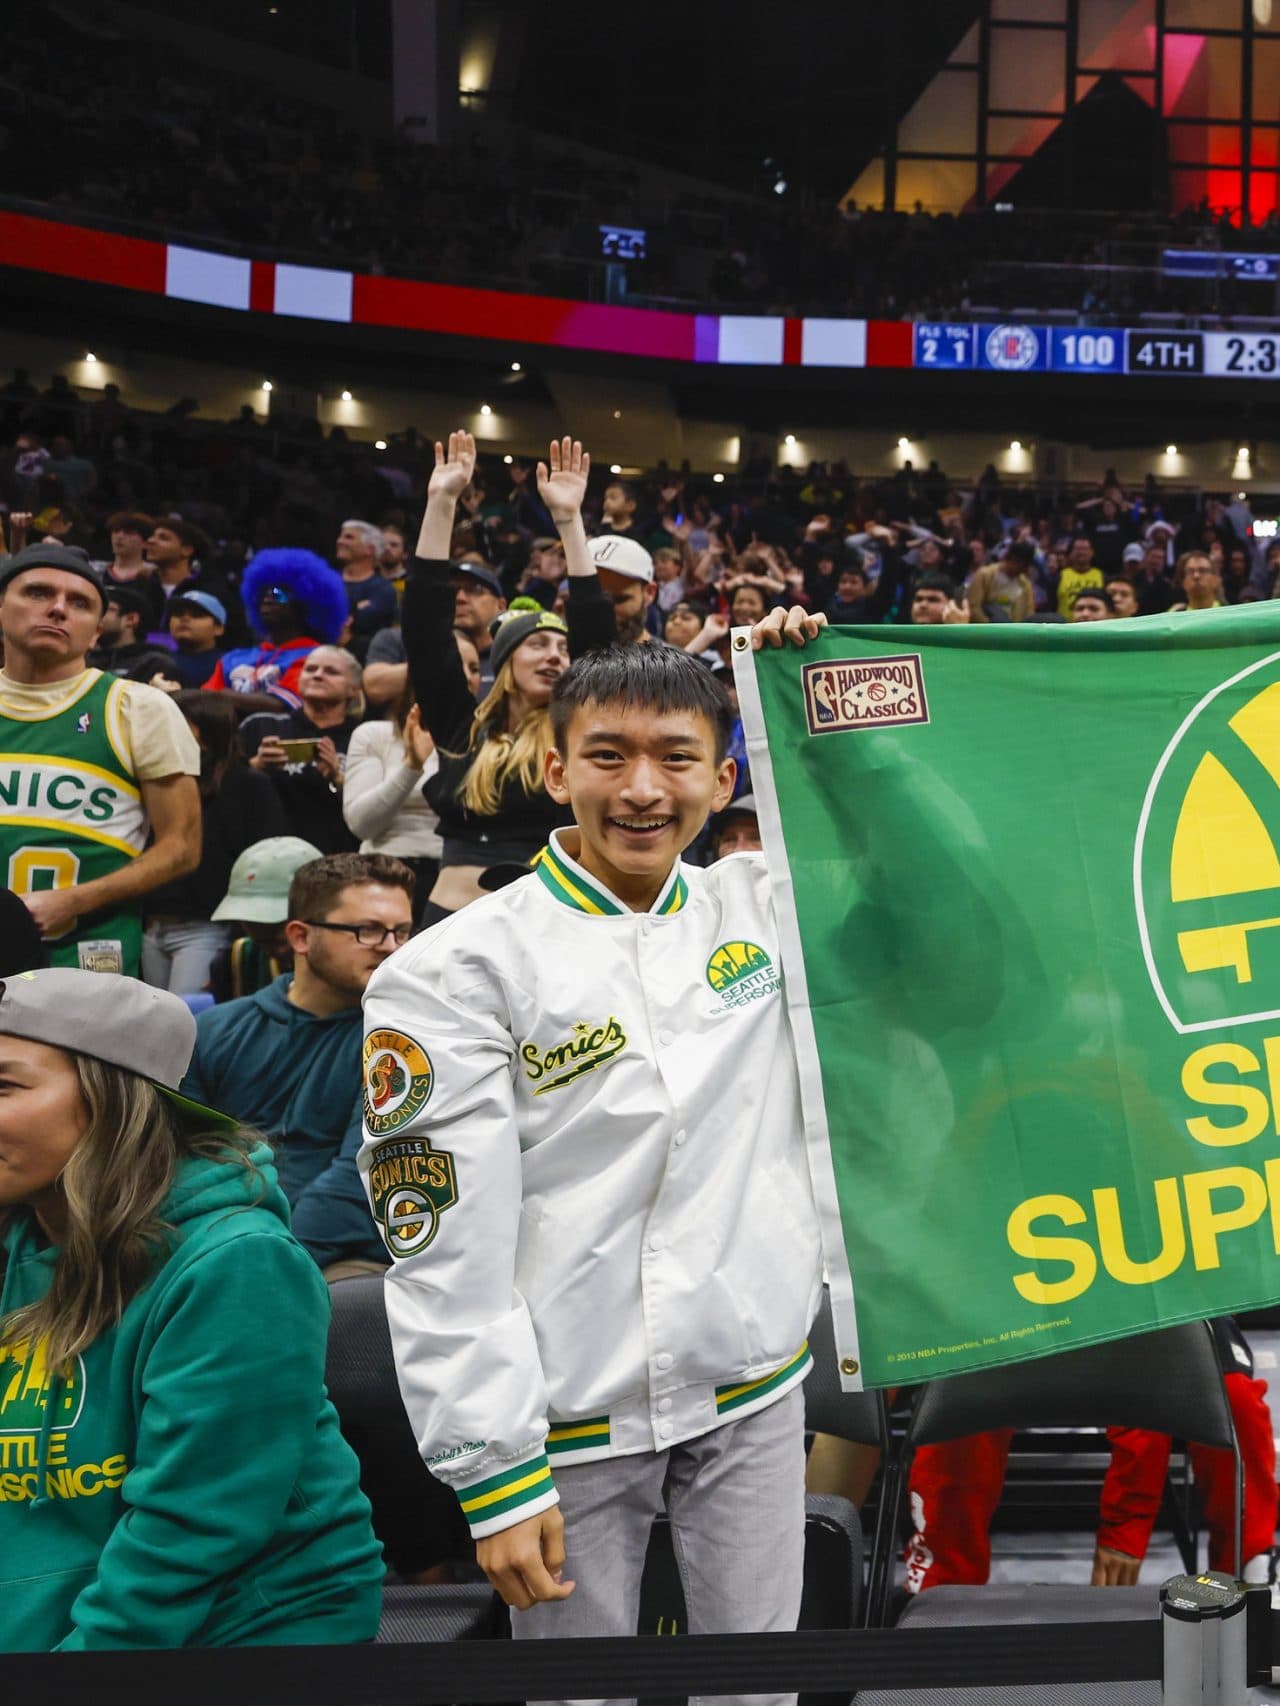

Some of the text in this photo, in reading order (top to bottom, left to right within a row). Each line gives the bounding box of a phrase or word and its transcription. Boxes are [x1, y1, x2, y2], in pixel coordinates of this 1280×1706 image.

[923, 340, 965, 363] 2 1
[1062, 335, 1114, 365] 100
[1136, 341, 1194, 367] 4TH
[836, 666, 913, 698] HARDWOOD
[840, 692, 917, 720] CLASSICS
[721, 967, 776, 1002] SEATTLE
[521, 1016, 627, 1084] Sonics
[376, 1142, 423, 1164] SEATTLE
[372, 1156, 448, 1201] SONICS
[897, 1352, 917, 1361] 2013
[918, 1347, 936, 1358] NBA
[1000, 1332, 1009, 1342] All
[1010, 1327, 1034, 1341] Rights
[0, 1433, 68, 1469] TTLE
[0, 1454, 128, 1502] SONICS
